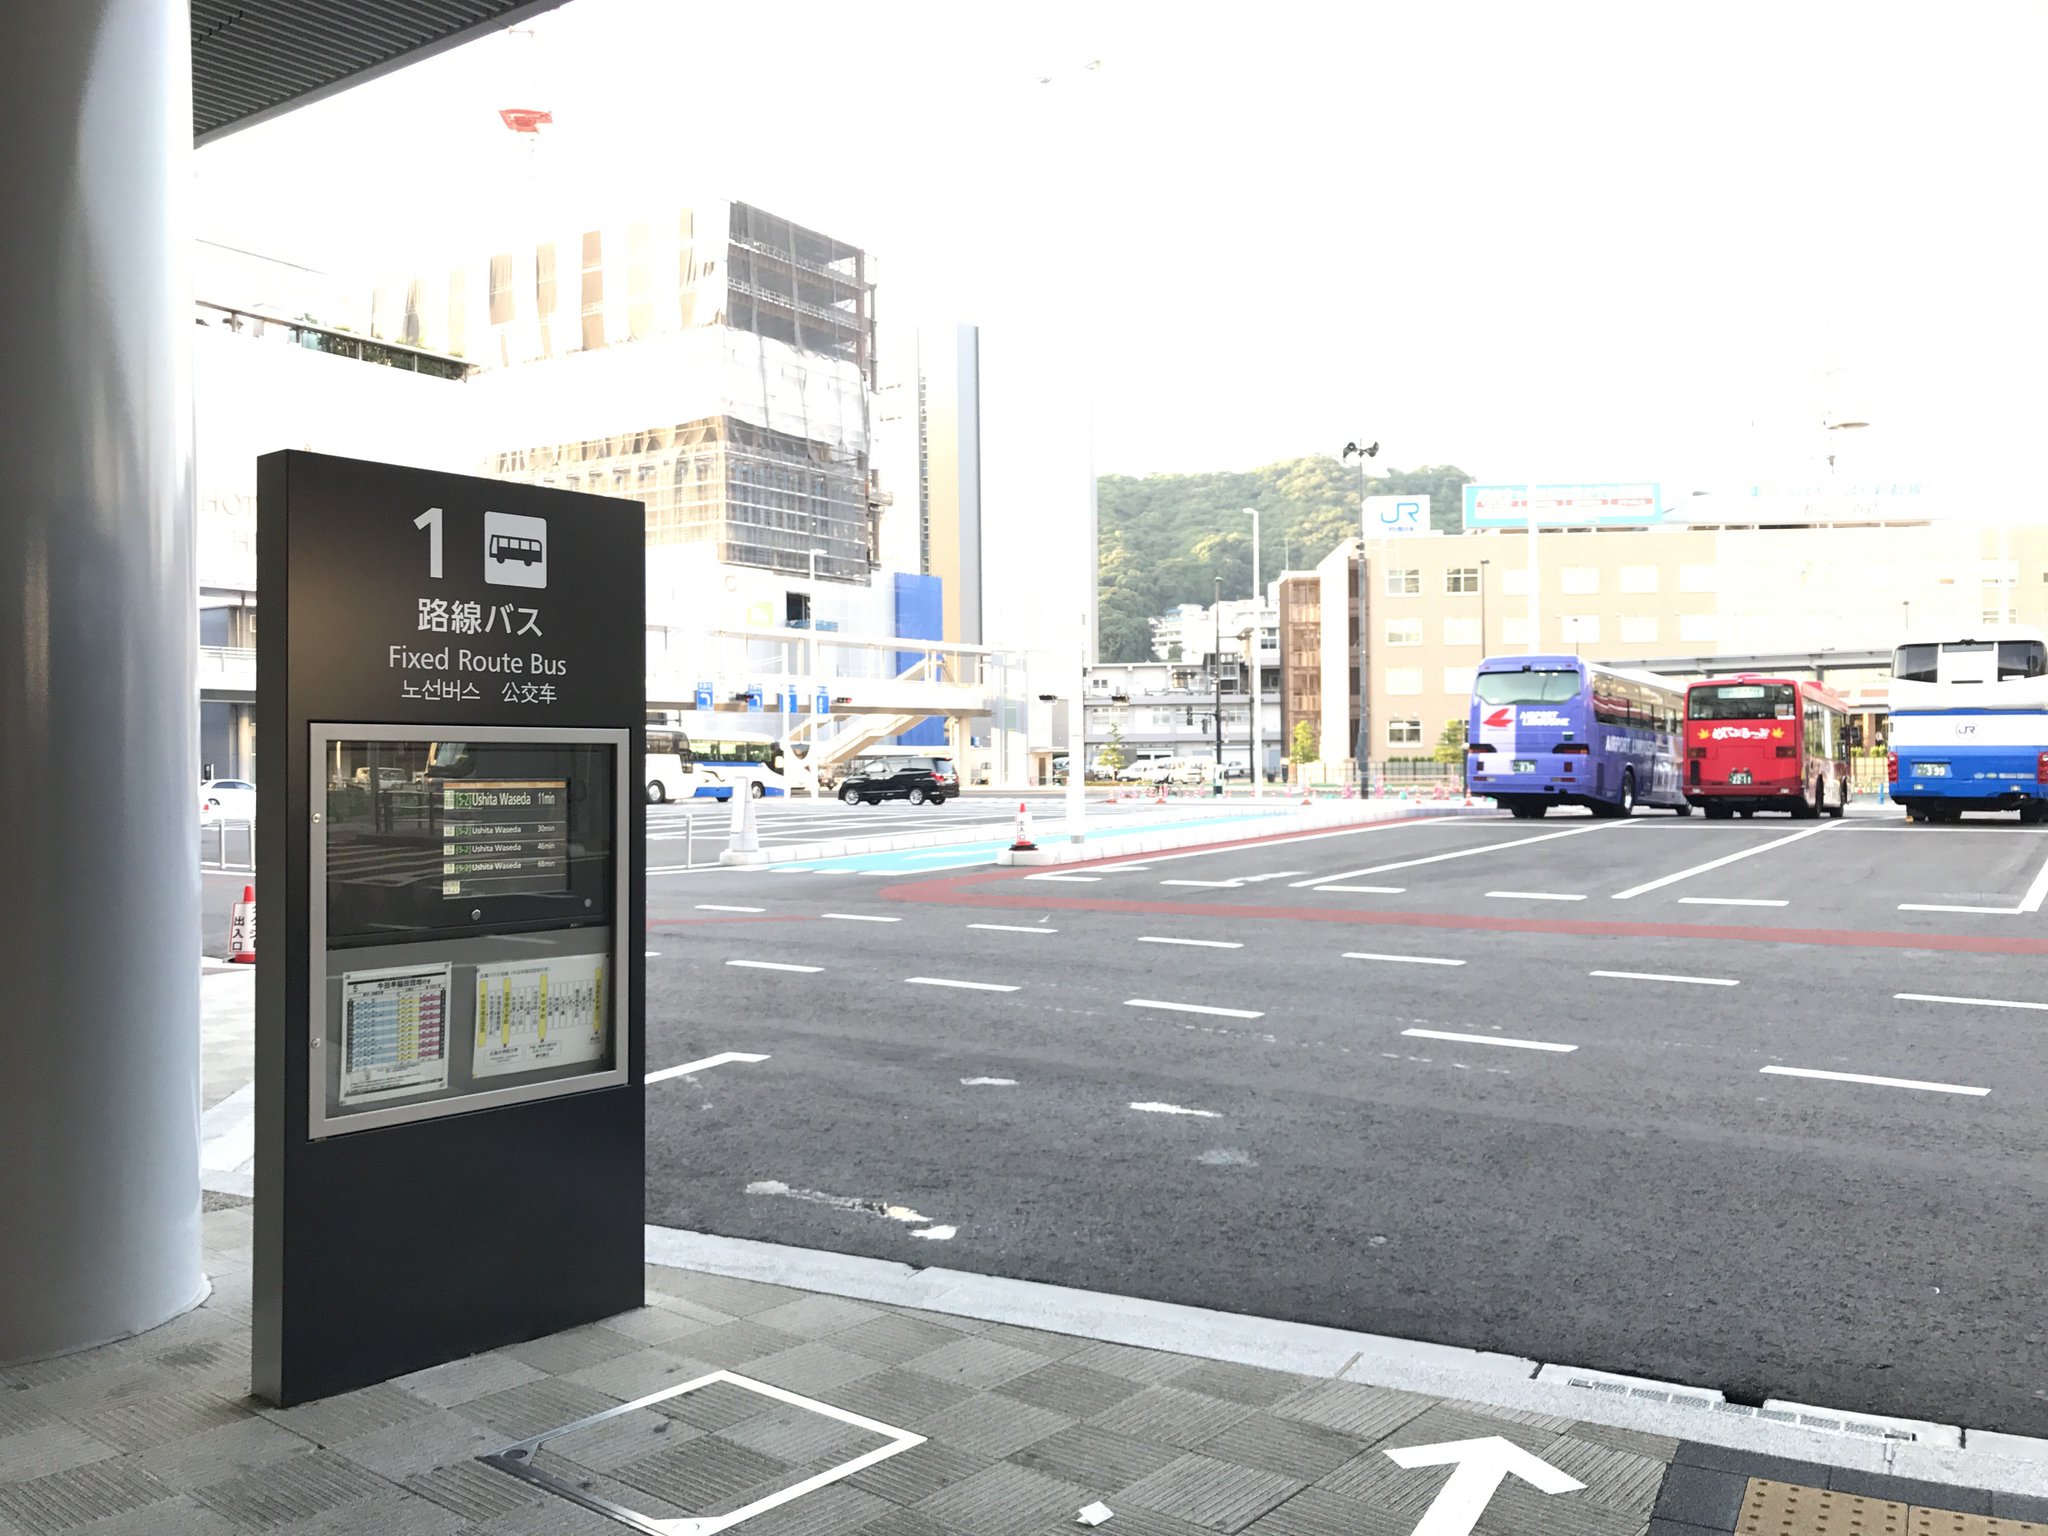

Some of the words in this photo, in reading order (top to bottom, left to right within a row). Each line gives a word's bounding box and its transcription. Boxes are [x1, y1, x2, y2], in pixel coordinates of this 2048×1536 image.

[1380, 502, 1420, 524] JR
[413, 507, 443, 579] 1
[417, 598, 543, 637] 路線バス
[389, 645, 449, 671] Fixed
[458, 649, 523, 674] Route
[530, 653, 567, 676] Bus
[401, 679, 481, 702] 노선버스
[501, 682, 558, 705] 公交车
[472, 792, 498, 806] Ushita
[499, 792, 531, 806] Waseda
[472, 827, 493, 835] Ushita
[494, 826, 521, 835] Waseda
[472, 845, 493, 853] Ushita
[494, 844, 521, 852] Waseda
[472, 863, 493, 872] Ushita
[494, 862, 521, 870] Waseda
[232, 916, 245, 951] 出入口
